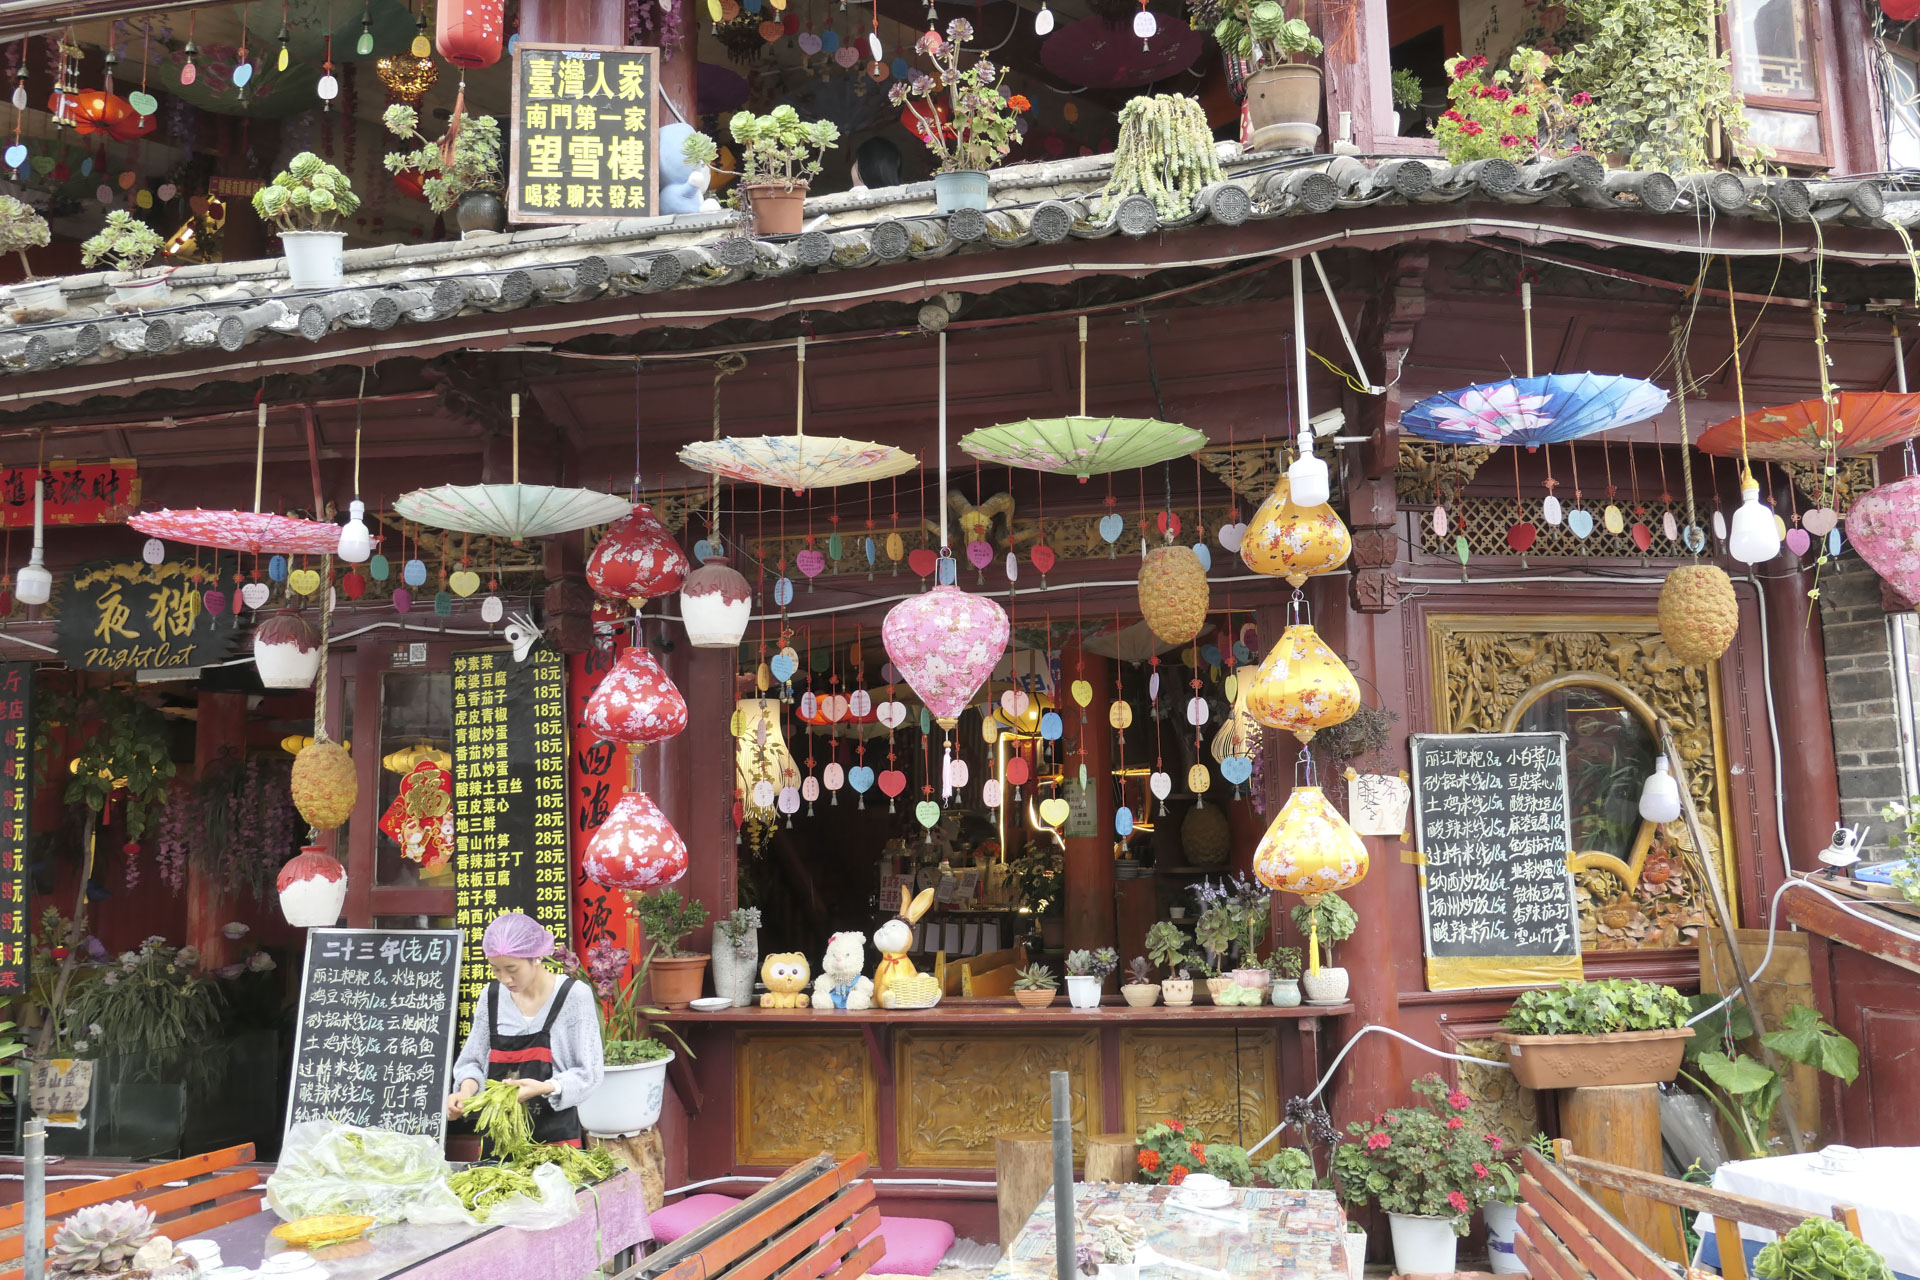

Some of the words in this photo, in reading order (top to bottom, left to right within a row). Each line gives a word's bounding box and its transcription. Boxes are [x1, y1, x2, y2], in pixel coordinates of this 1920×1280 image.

[528, 59, 645, 101] 臺灣人家
[525, 103, 646, 132] 南門第一家
[527, 134, 645, 181] 望雪樓
[525, 184, 562, 208] 喝茶
[567, 184, 604, 208] 聊天
[609, 185, 646, 209] 發呆
[94, 581, 195, 644] 夜猫
[454, 654, 493, 672] 炒素菜
[0, 669, 23, 692] 厅
[454, 671, 507, 690] 麻婆豆腐
[533, 666, 561, 681] 18元
[455, 689, 507, 708] 鱼香茄子
[533, 684, 561, 699] 18元
[455, 706, 507, 726] 虎皮青椒
[534, 702, 561, 717] 18元
[455, 724, 508, 744] 青椒炒蛋
[534, 720, 562, 735] 18元
[455, 742, 508, 762] 番茄炒蛋
[534, 738, 562, 753] 18元
[455, 760, 509, 780] 苦瓜炒蛋
[535, 756, 563, 772] 18元
[406, 769, 450, 818] 福
[455, 778, 522, 798] 酸辣土豆丝
[535, 775, 563, 790] 16元
[456, 797, 510, 815] 豆皮菜心
[536, 793, 564, 808] 18元
[456, 816, 496, 834] 地三鲜
[535, 811, 564, 827] 28元
[456, 833, 510, 852] 雪山竹笋
[535, 830, 565, 845] 28元
[456, 851, 524, 870] 香辣茄子丁
[535, 848, 565, 864] 28元
[456, 870, 510, 888] 铁板豆腐
[536, 867, 566, 883] 28元
[457, 889, 497, 907] 茄子煲
[536, 885, 566, 901] 28元
[537, 904, 566, 920] 38元
[541, 923, 566, 939] 8元
[390, 992, 446, 1011] 红杏出墙
[384, 1036, 435, 1059] 石锅鱼
